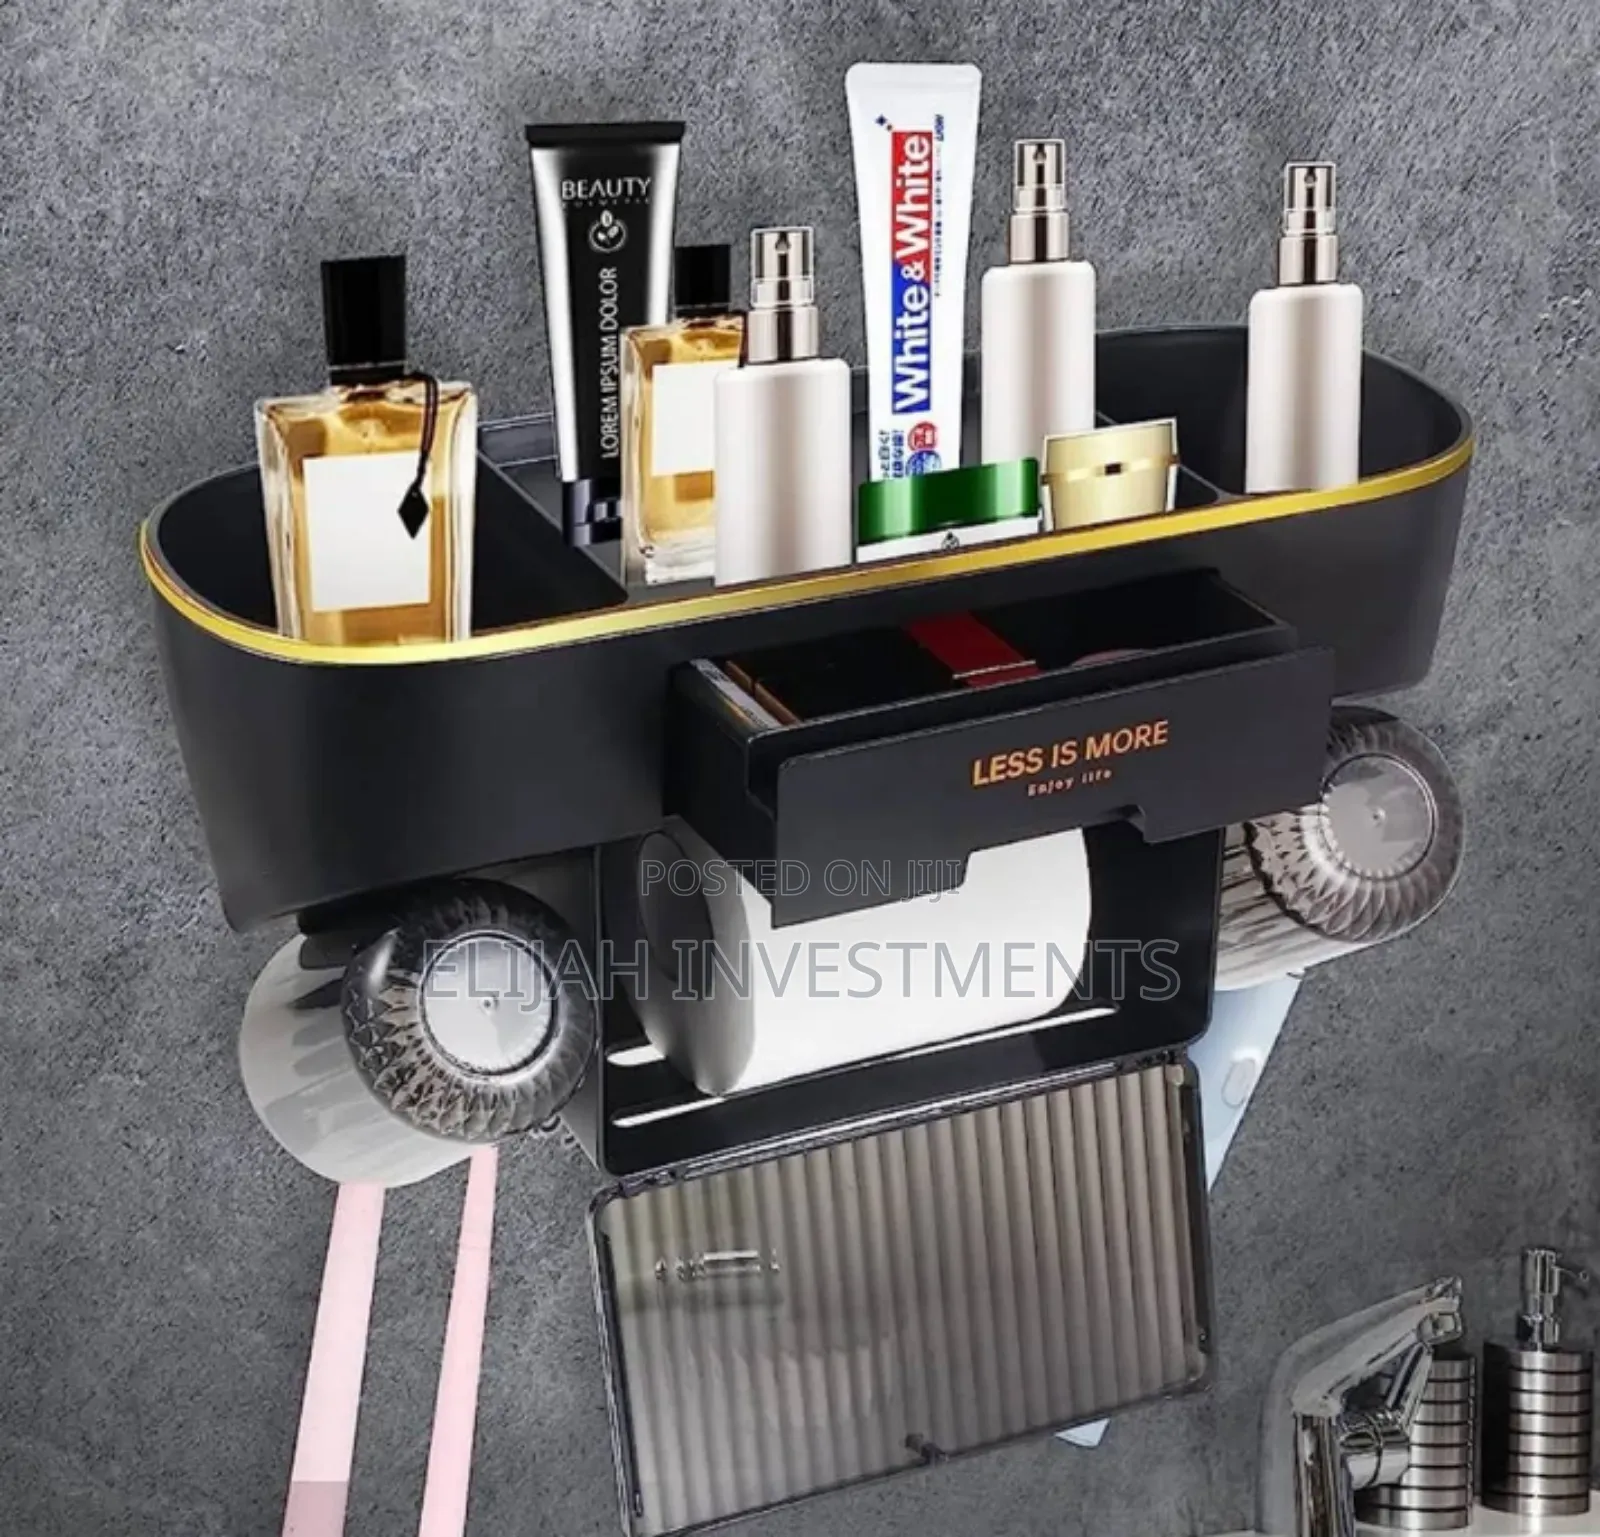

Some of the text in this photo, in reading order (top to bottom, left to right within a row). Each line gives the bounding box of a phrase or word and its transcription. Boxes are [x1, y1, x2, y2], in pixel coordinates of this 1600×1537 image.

[561, 177, 651, 200] BEAUTY
[599, 267, 619, 458] LOREM IPSUM DOLOR
[972, 719, 1169, 786] LESS IS MORE
